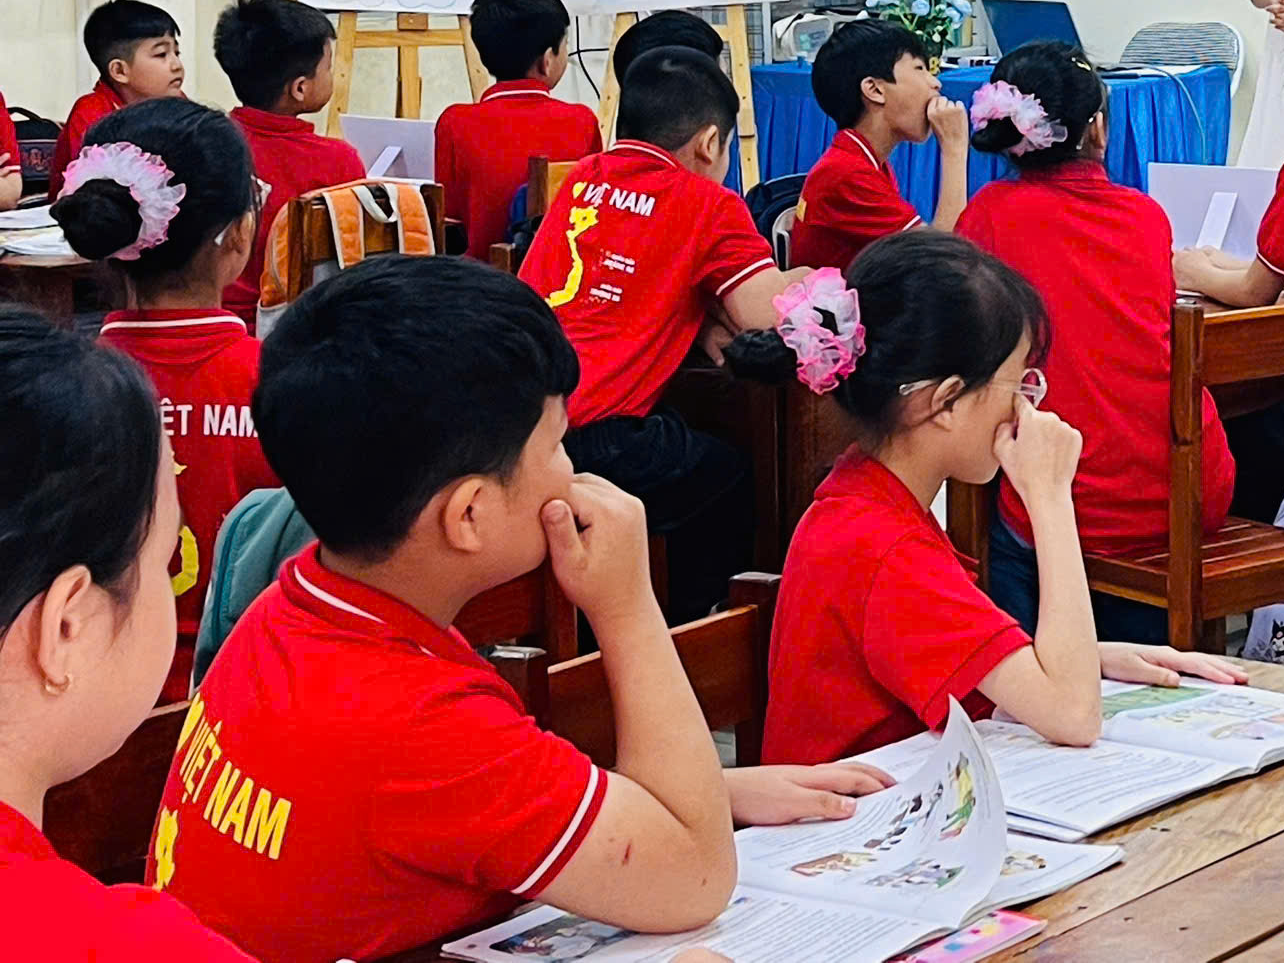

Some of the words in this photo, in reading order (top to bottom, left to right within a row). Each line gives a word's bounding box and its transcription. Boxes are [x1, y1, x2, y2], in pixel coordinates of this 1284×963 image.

[609, 188, 656, 217] NAM
[204, 404, 258, 438] NAM
[204, 761, 292, 860] NAM
